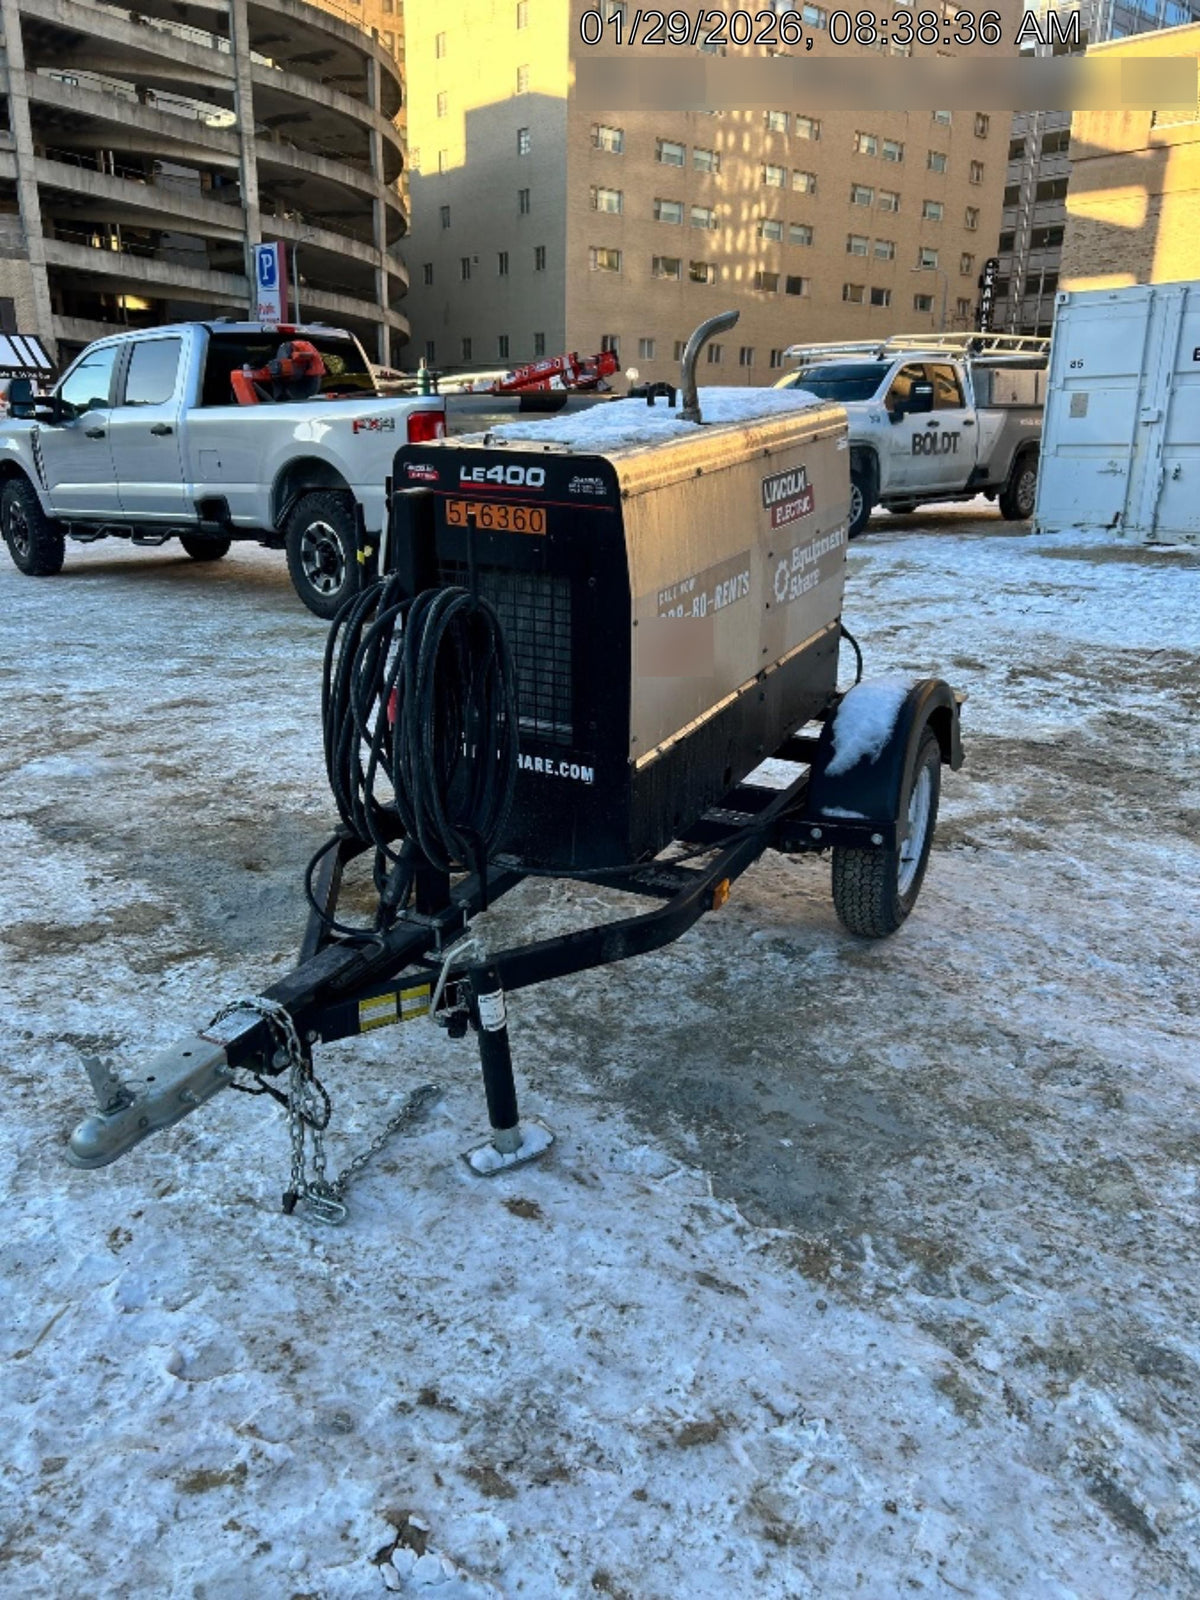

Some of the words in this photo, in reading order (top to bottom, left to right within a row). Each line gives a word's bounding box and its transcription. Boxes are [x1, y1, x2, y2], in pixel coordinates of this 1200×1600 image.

[260, 253, 273, 280] P
[911, 431, 961, 457] BOLDT
[459, 464, 547, 488] LE400
[763, 470, 806, 505] LINCOLN
[791, 524, 846, 573] Equipment
[789, 567, 820, 601] Share
